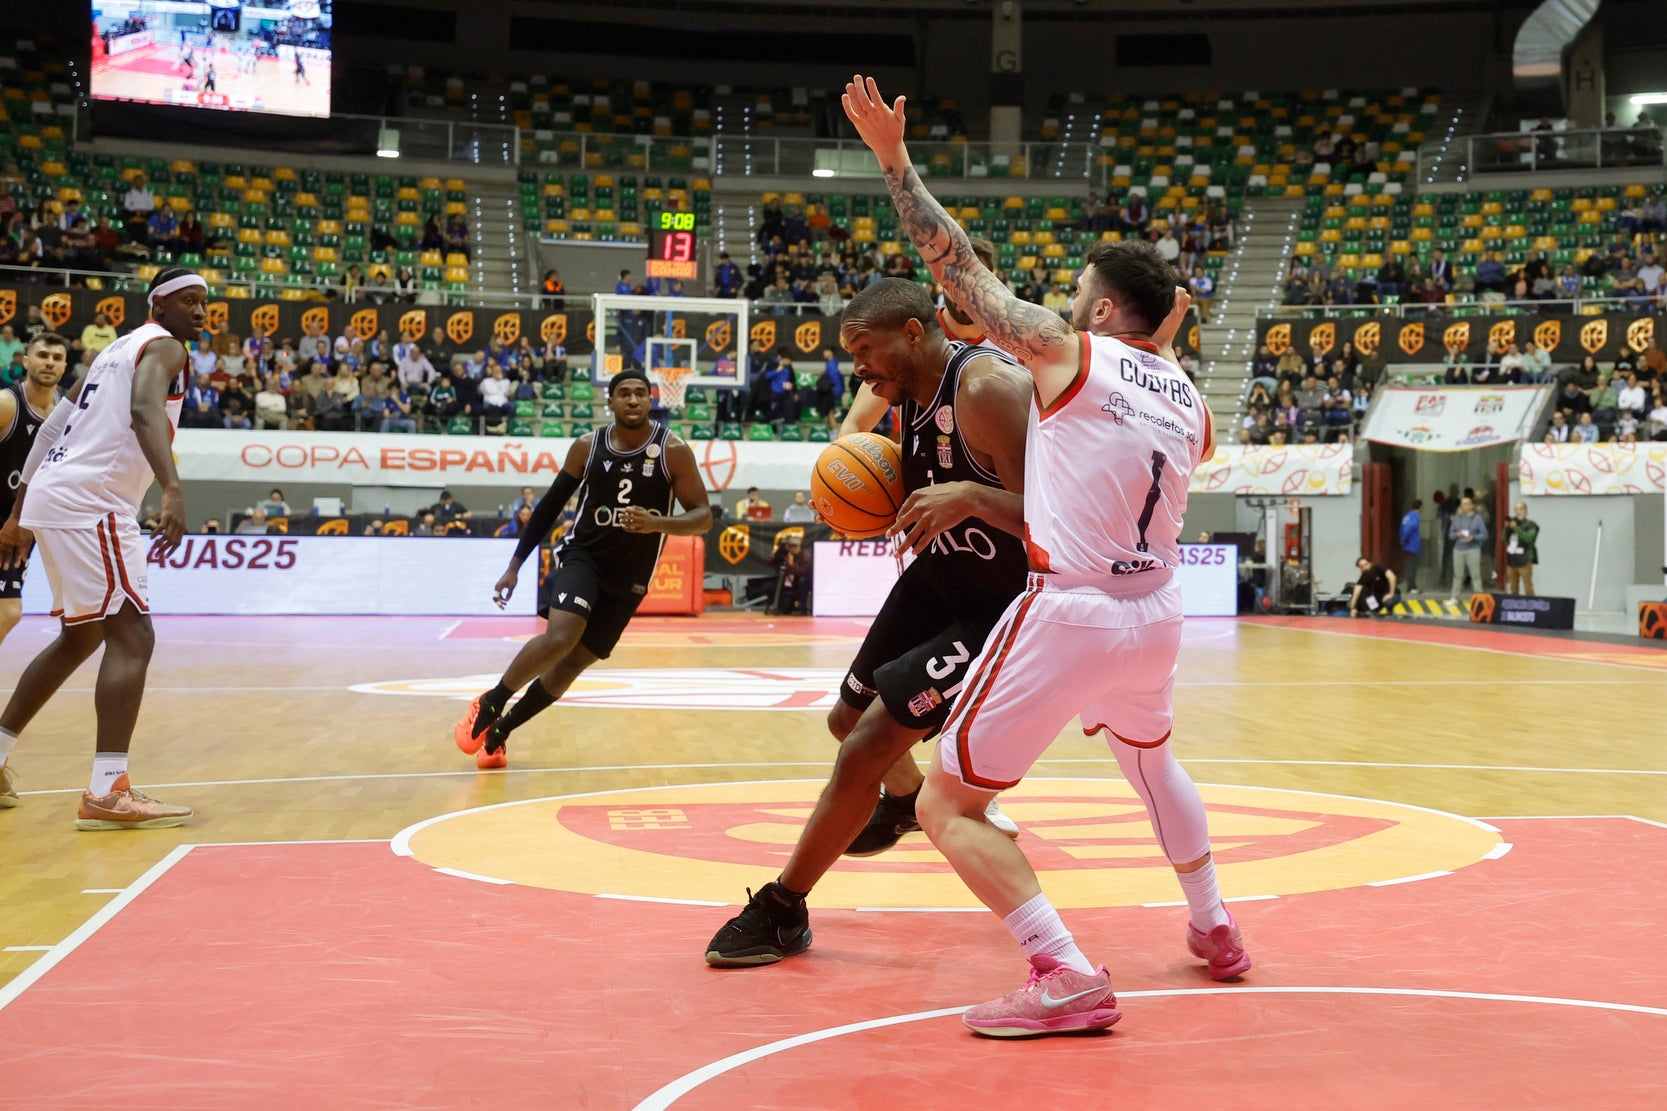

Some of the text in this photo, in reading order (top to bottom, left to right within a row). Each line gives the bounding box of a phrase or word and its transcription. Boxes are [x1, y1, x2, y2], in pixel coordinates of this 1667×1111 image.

[996, 50, 1017, 73] G
[660, 212, 696, 231] 9:08
[664, 232, 692, 262] 13
[1139, 411, 1185, 436] recoletas
[241, 443, 561, 473] COPA ESPAÑA
[846, 434, 897, 486] Wilson
[617, 478, 633, 504] 2
[1136, 450, 1167, 553] 1
